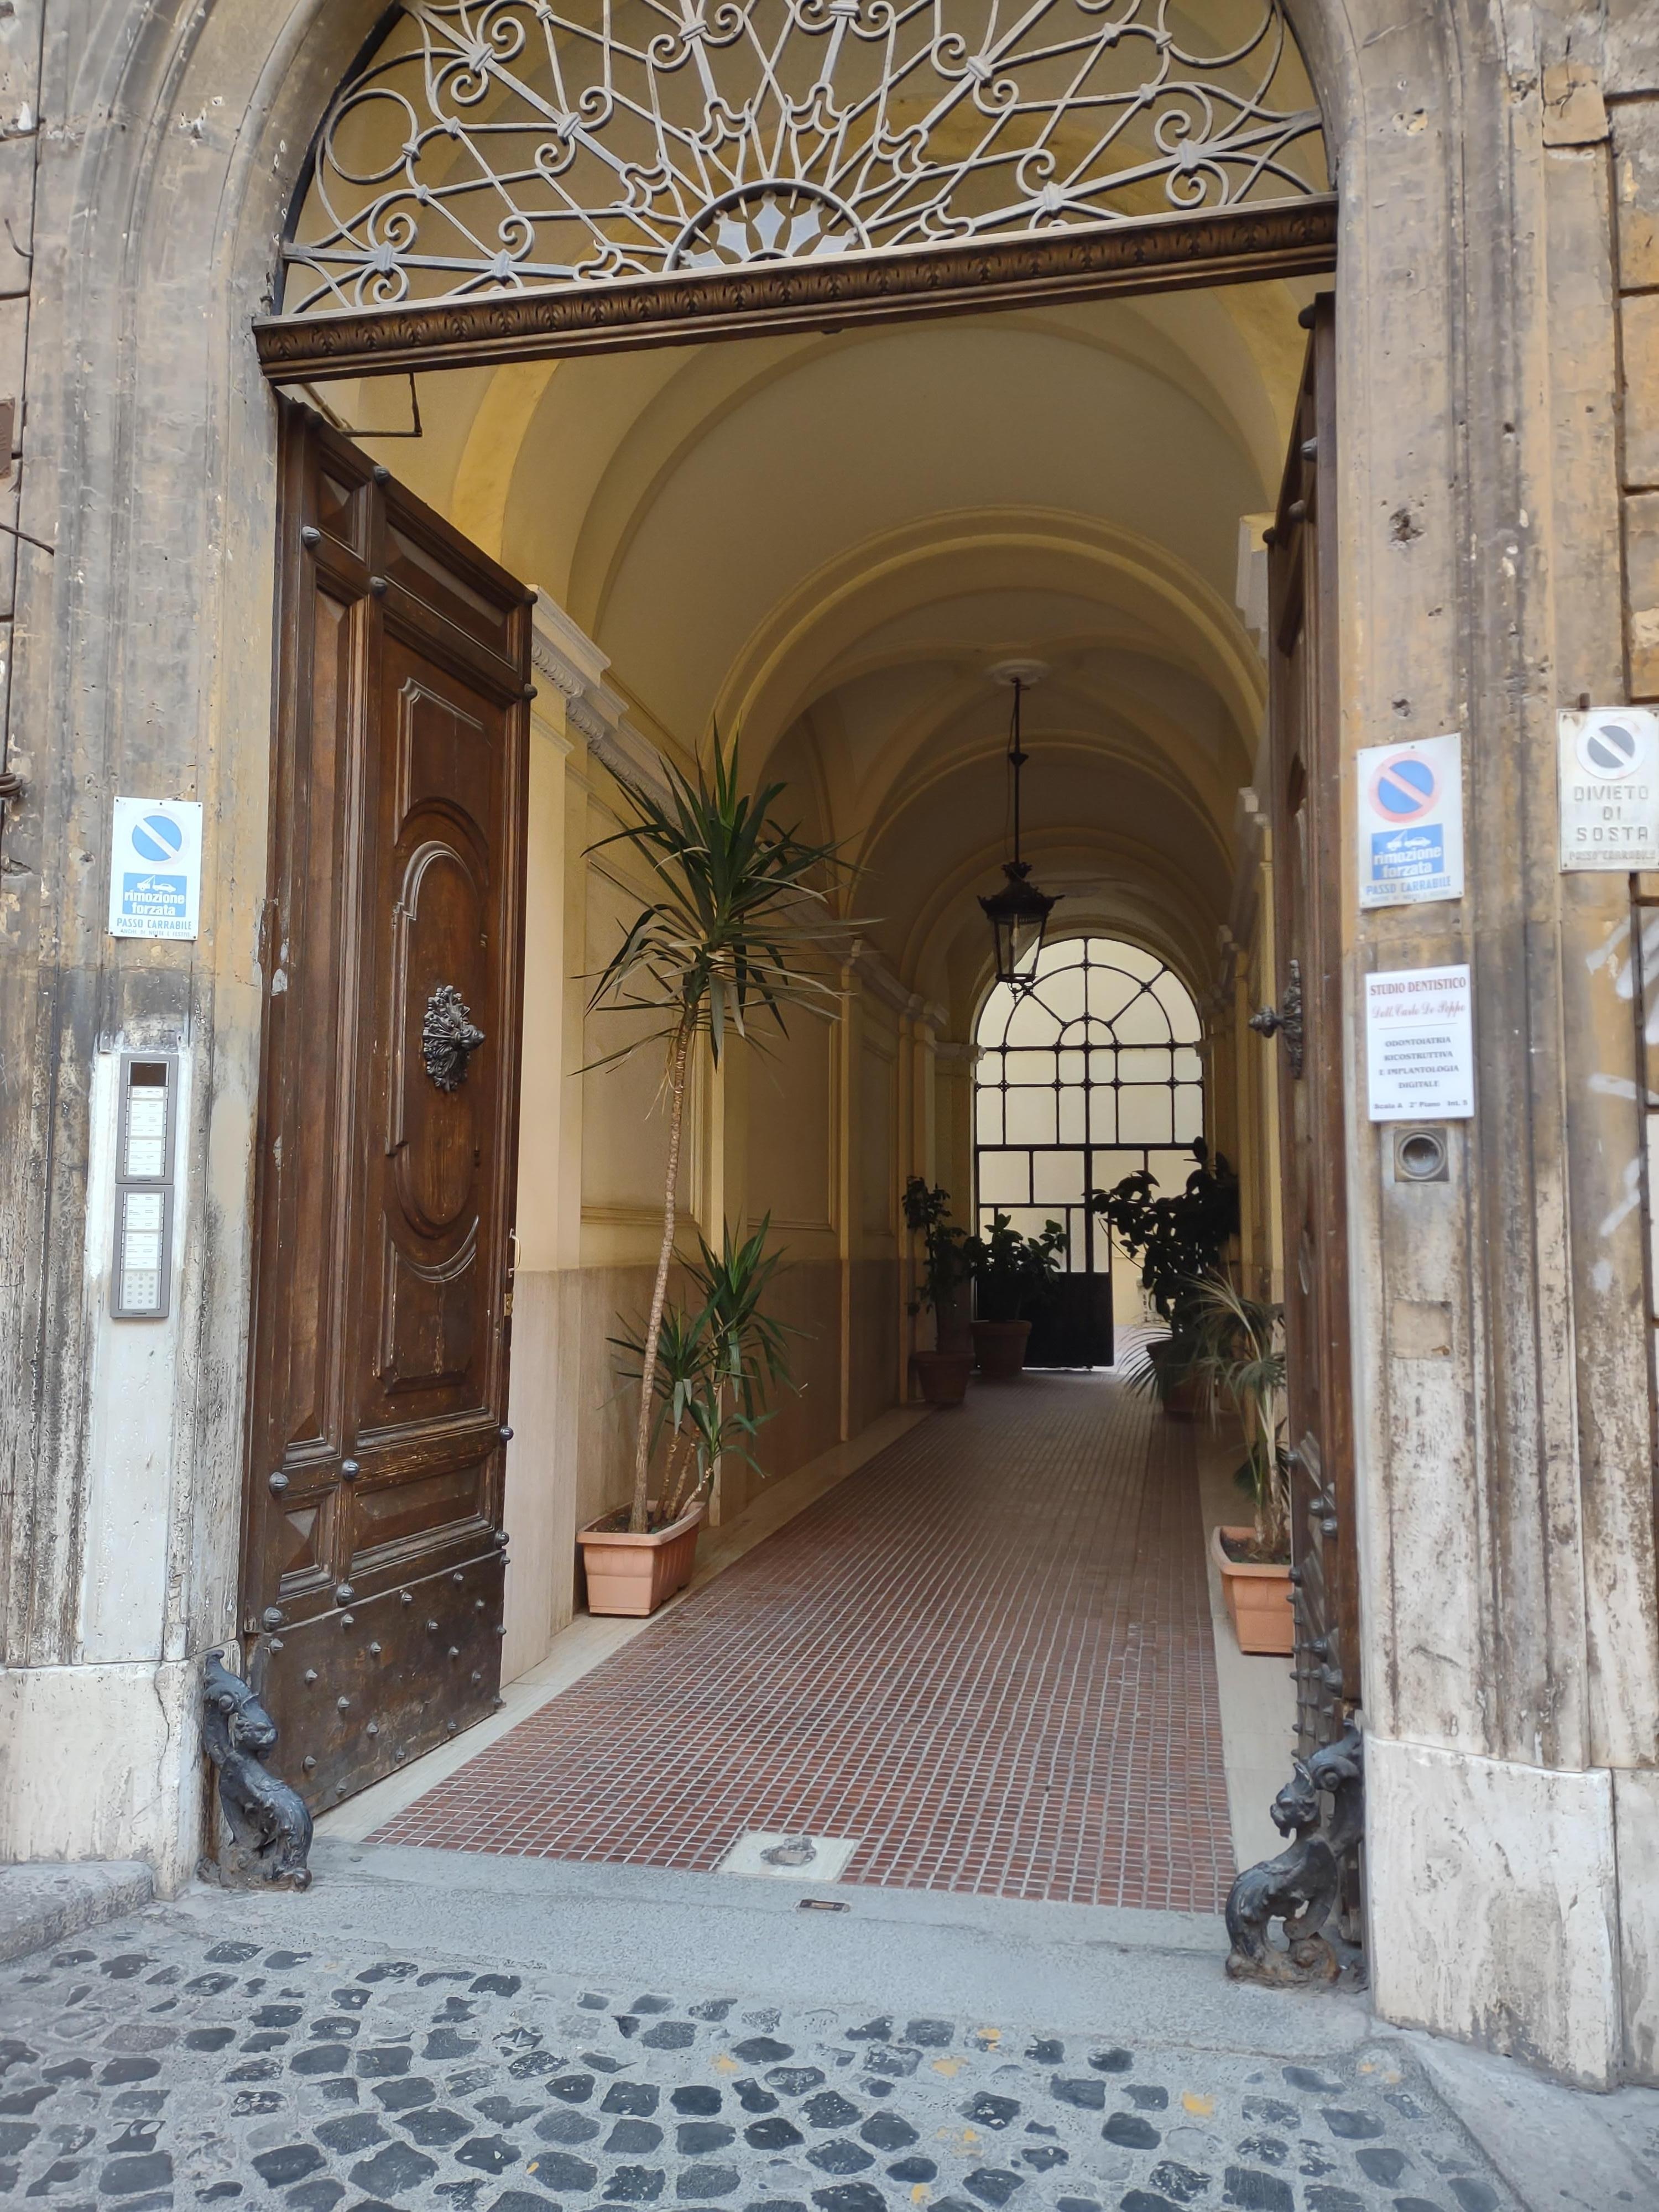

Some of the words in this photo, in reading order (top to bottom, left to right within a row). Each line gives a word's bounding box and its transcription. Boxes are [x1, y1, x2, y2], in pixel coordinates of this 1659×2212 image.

[1574, 785, 1648, 801] DIVIETO
[1603, 806, 1621, 821] DI
[1577, 827, 1648, 841] SOSTA
[1374, 847, 1442, 865] rimozione
[1383, 862, 1432, 877] forzata
[1365, 884, 1396, 895] PASSO
[1401, 876, 1451, 892] CARRABILE
[124, 890, 185, 904] rimozione
[132, 902, 176, 915] forzata
[117, 918, 143, 928] PASSO
[147, 920, 191, 930] CARRABILE
[1370, 983, 1405, 996] STUDIO
[1407, 977, 1466, 993] DENTISTICO
[1385, 1036, 1451, 1047] ODONTOIATRIA
[1384, 1051, 1454, 1061] RICOSTRUTTIVA
[1387, 1065, 1459, 1076] IMPLANTOLOGIA
[1398, 1080, 1439, 1089] DIGITALE
